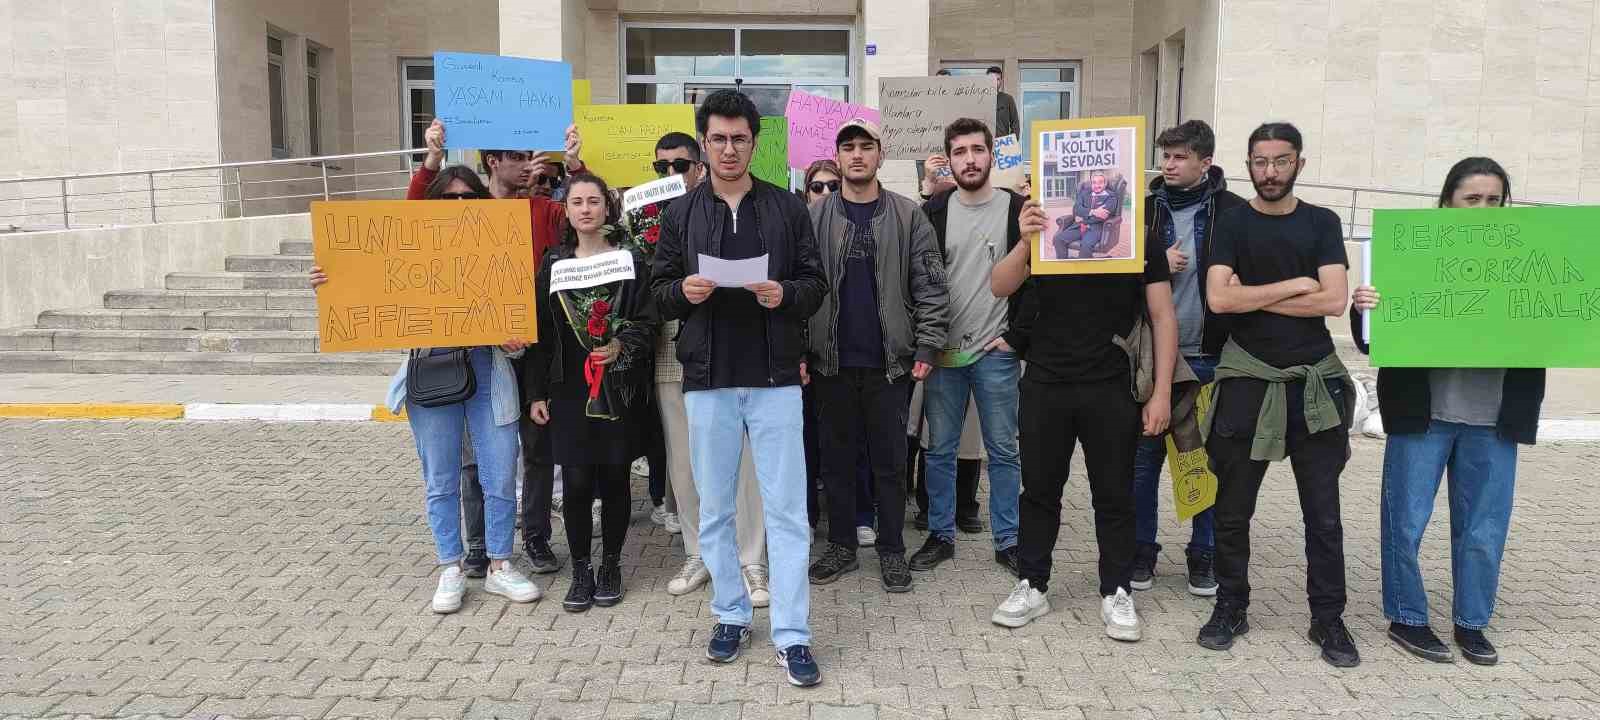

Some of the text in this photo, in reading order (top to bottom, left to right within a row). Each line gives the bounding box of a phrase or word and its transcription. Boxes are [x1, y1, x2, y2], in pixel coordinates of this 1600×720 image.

[790, 95, 858, 119] HAYVAN
[1061, 138, 1114, 154] KOLTUK
[1061, 153, 1116, 169] SEVDASI
[324, 205, 529, 254] UNUTMA
[1391, 223, 1525, 252] REKTÖR
[383, 251, 534, 300] KORKMA
[1434, 249, 1585, 286] KORKMA
[324, 296, 530, 343] AFFETME
